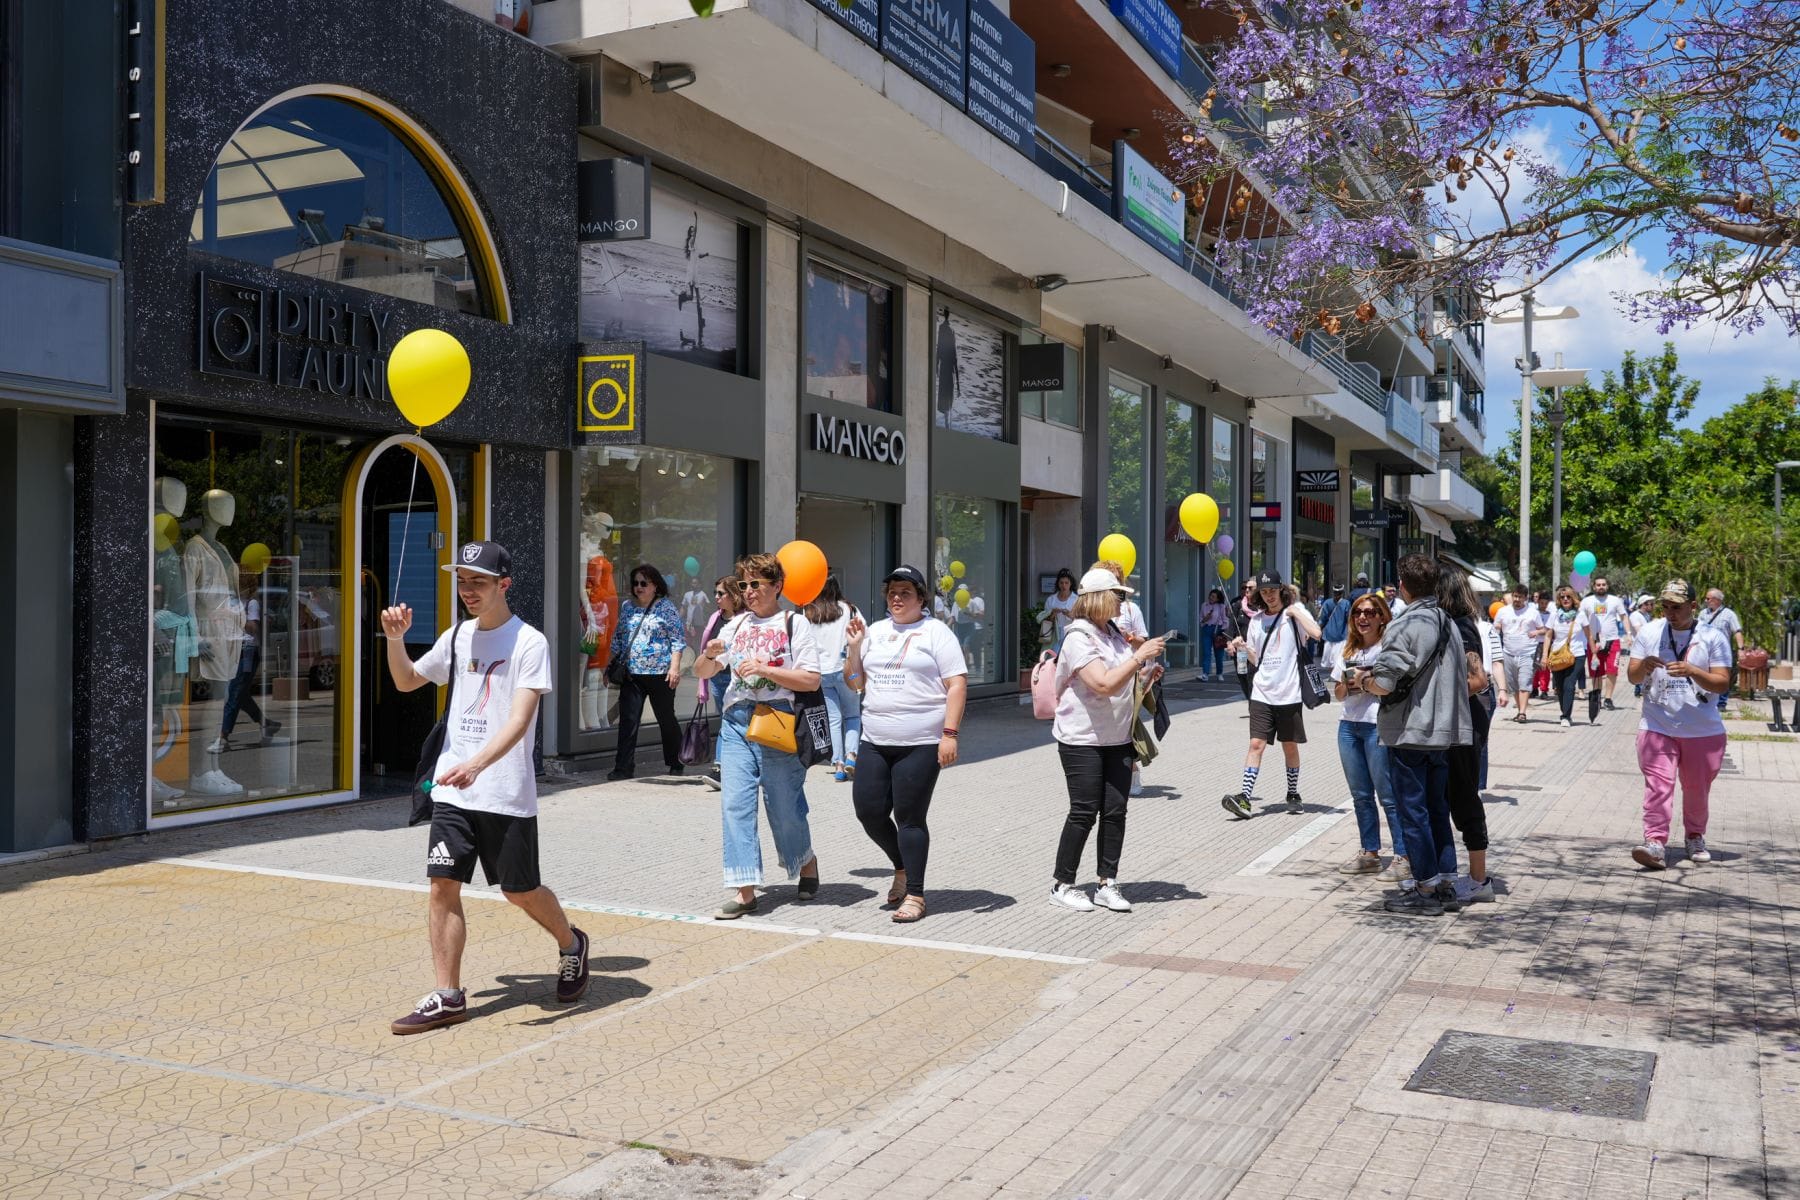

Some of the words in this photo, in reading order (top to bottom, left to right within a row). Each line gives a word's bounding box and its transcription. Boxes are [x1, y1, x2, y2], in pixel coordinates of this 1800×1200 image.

[897, 0, 961, 50] ERMA
[580, 218, 638, 234] MANGO
[278, 290, 389, 351] DIRTY
[277, 341, 389, 402] LAUN
[1022, 378, 1060, 388] MANGO
[811, 412, 906, 466] MANGO
